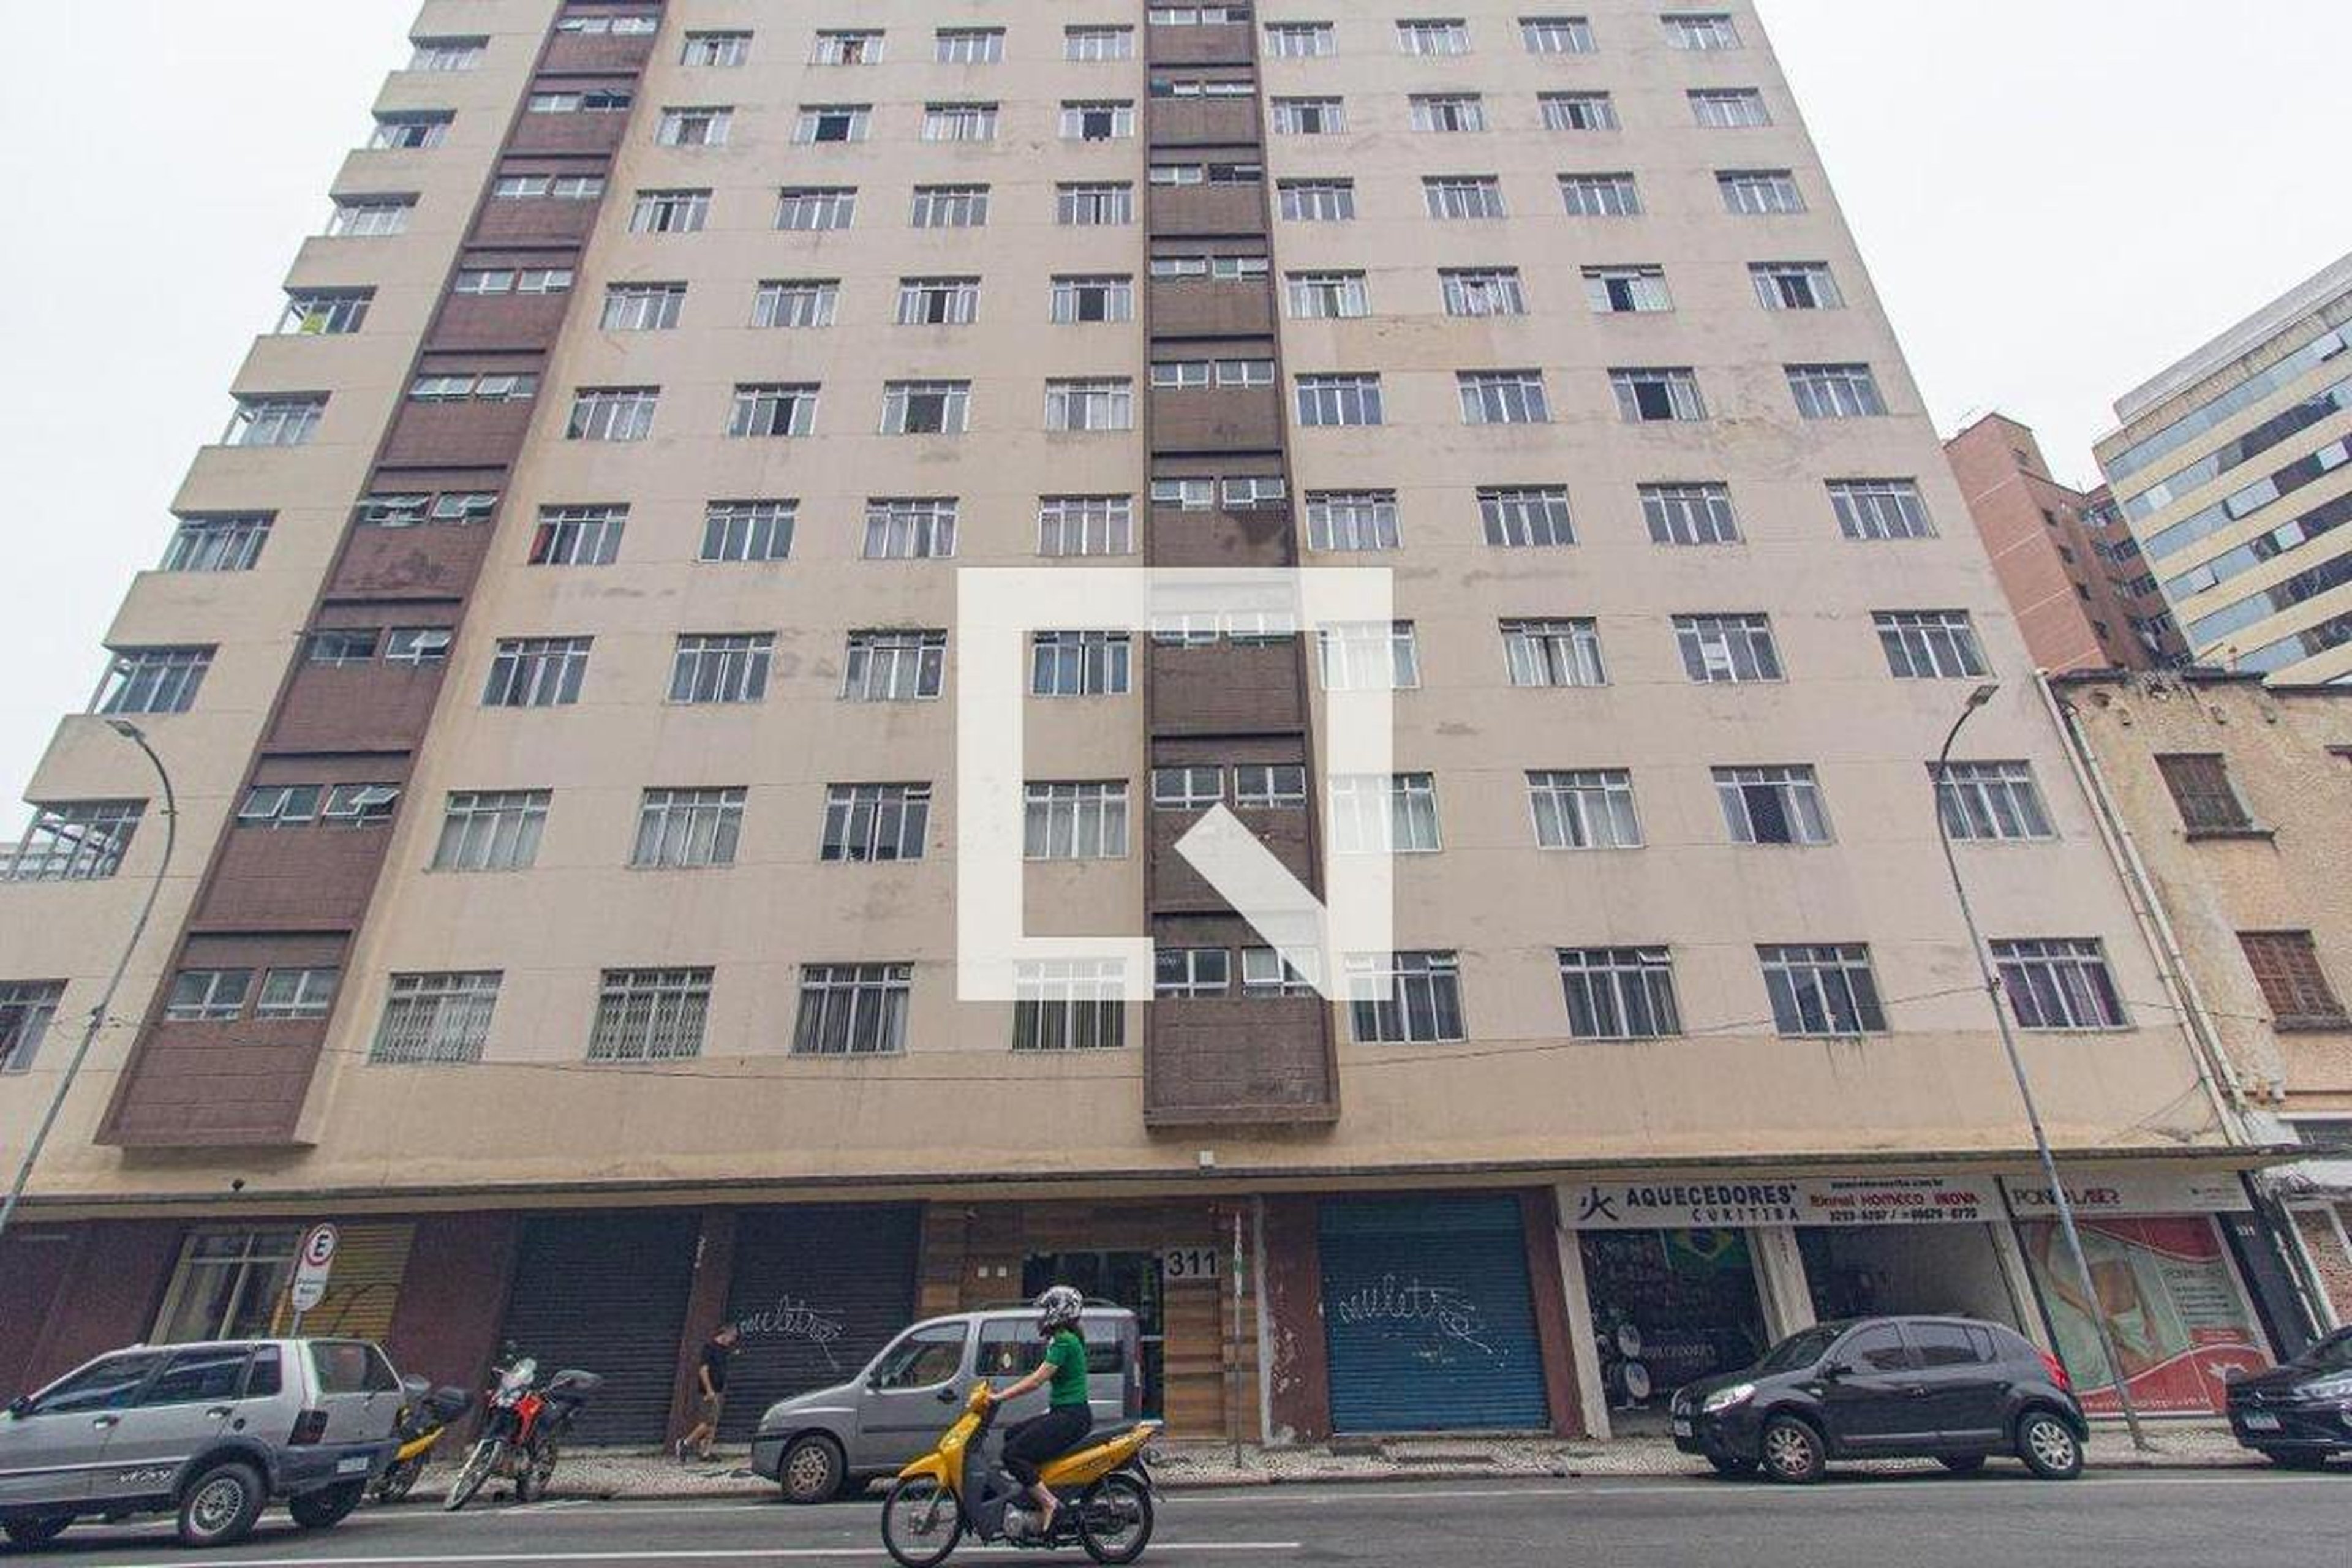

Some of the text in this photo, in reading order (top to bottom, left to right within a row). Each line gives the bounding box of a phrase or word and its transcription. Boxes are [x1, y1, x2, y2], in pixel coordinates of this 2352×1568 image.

[1627, 1185, 1793, 1207] AQUECEDORES
[314, 1234, 330, 1257] E
[1169, 1250, 1215, 1276] 311
